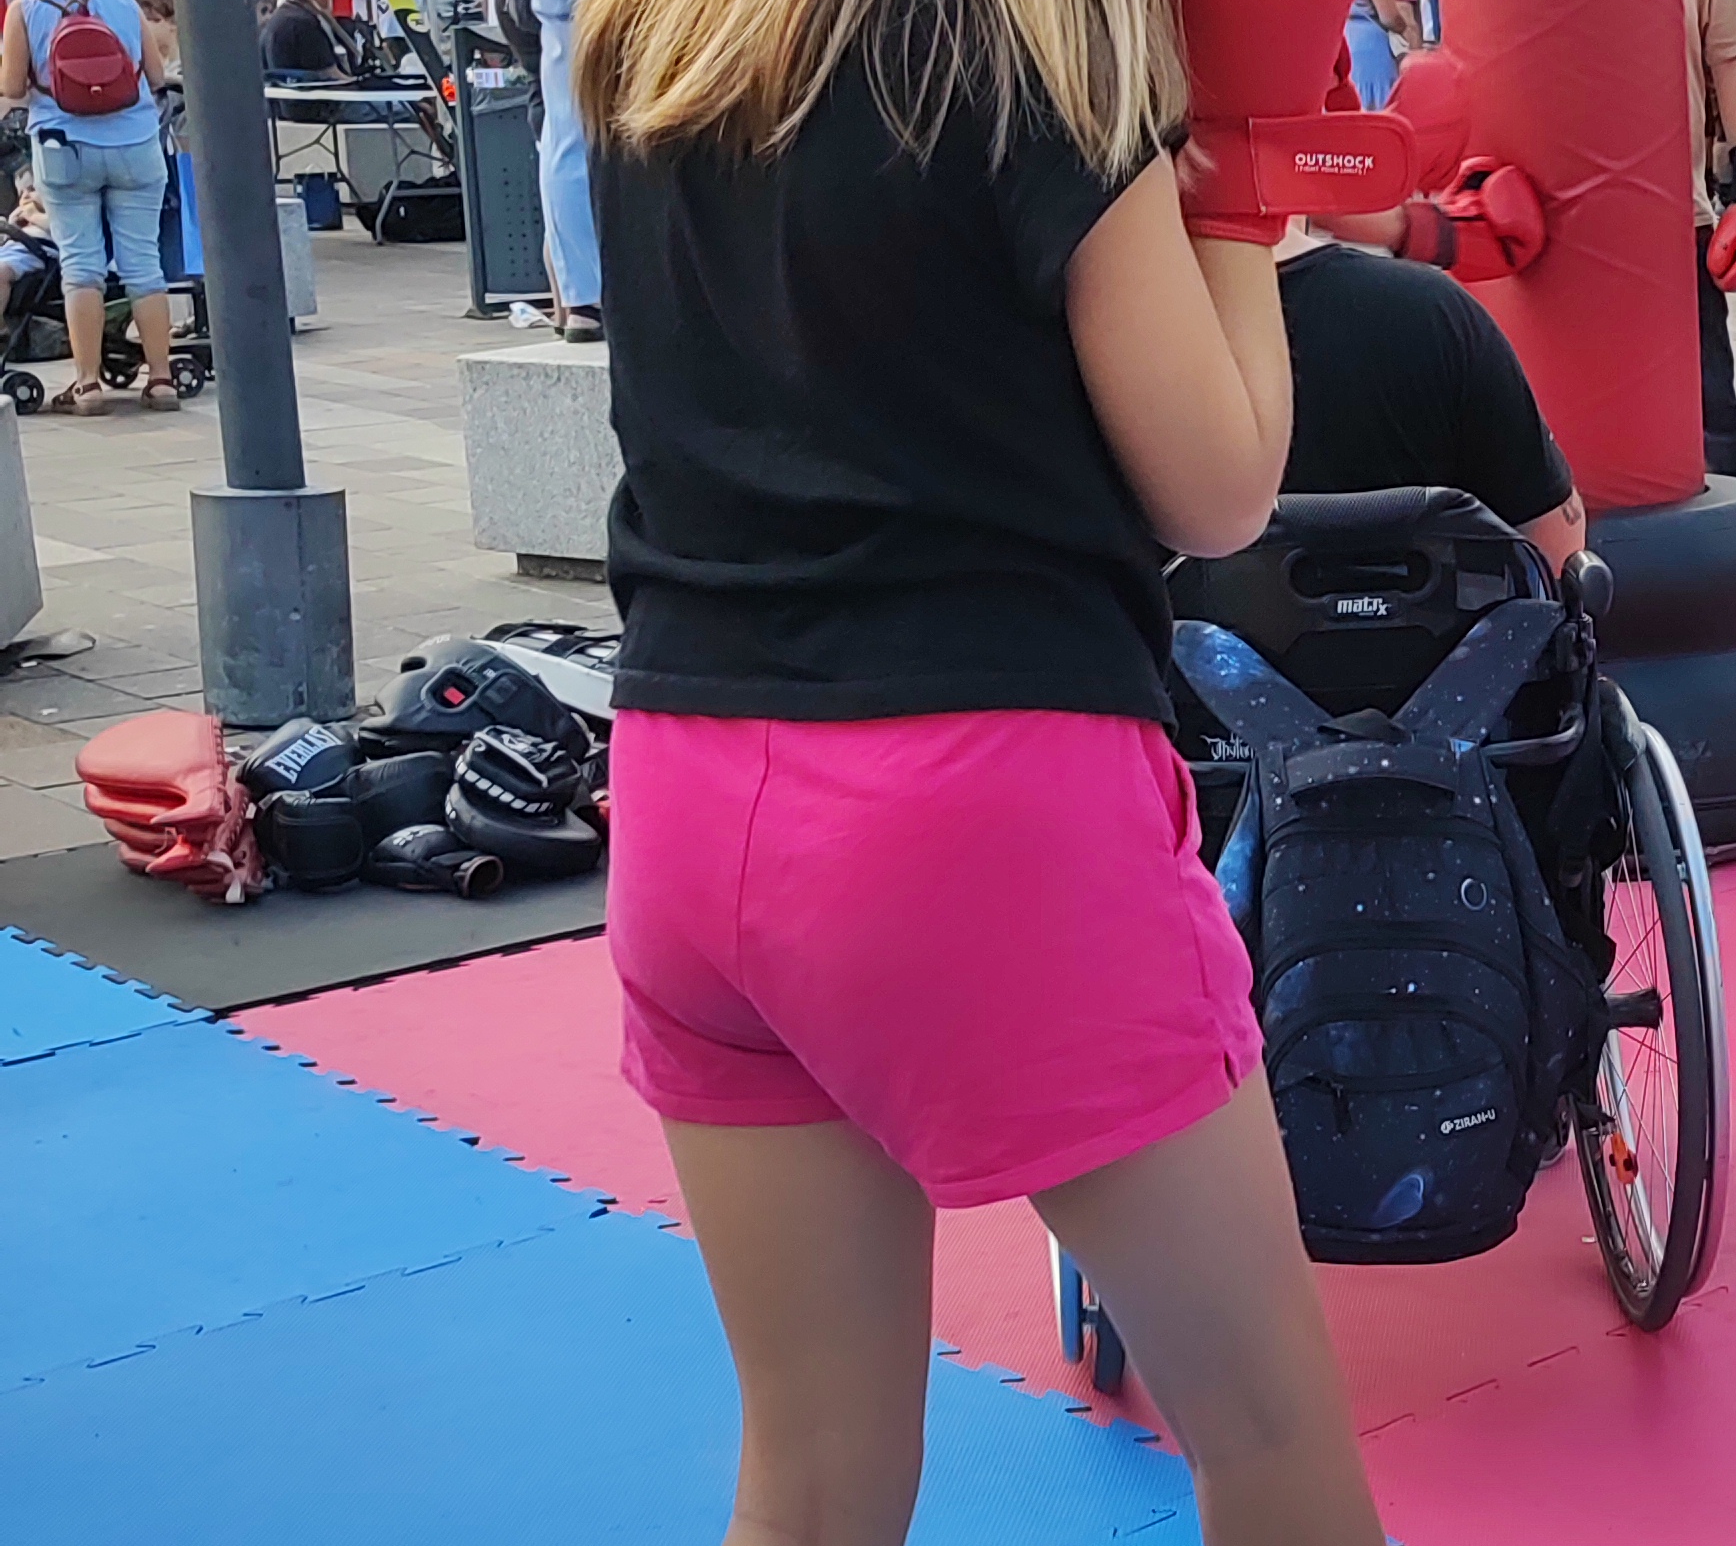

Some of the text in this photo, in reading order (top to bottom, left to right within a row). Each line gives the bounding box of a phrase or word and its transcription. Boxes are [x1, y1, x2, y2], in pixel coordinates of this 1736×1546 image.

[1295, 153, 1374, 169] OUTSHOCK
[264, 724, 343, 784] EVERLAST
[1453, 1108, 1496, 1131] ZIRAN-U
